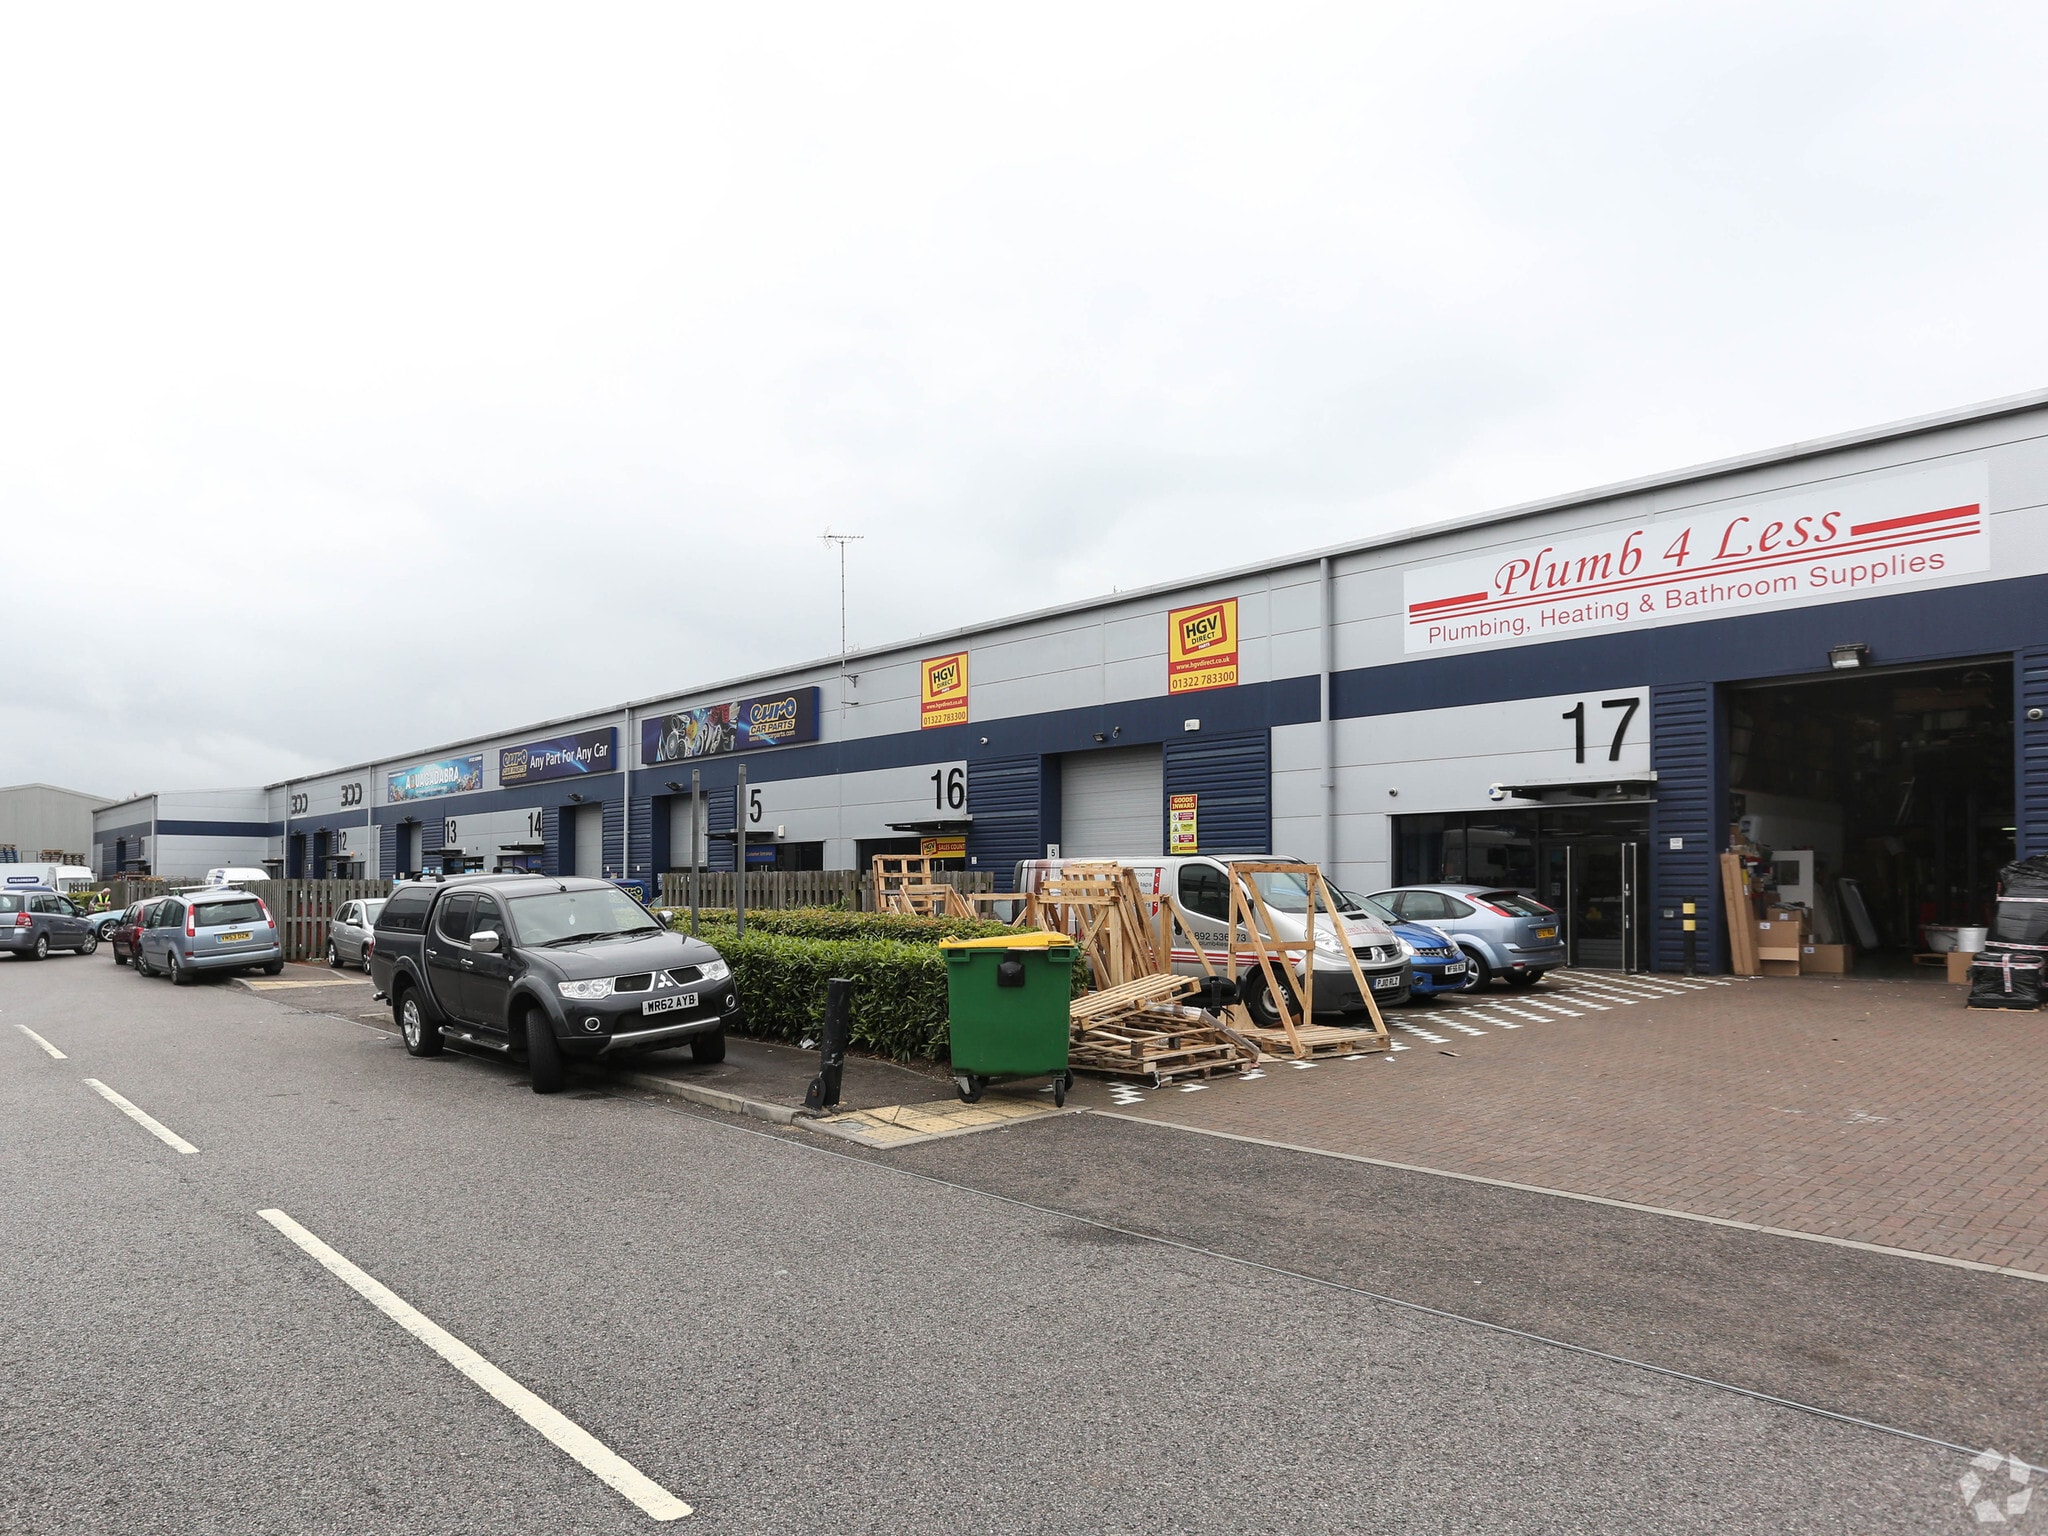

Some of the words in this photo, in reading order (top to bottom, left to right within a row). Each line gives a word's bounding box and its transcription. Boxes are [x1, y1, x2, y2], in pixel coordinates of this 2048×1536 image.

[1495, 530, 1642, 597] Plumb
[1663, 527, 1691, 567] 4
[1711, 511, 1841, 560] Less
[1429, 617, 1531, 644] Plumbing,
[1541, 601, 1629, 627] Heating
[1639, 593, 1656, 613] &
[1666, 575, 1797, 609] Bathroom
[1809, 552, 1945, 587] Supplies
[1185, 614, 1218, 639] HGV
[1191, 631, 1215, 645] DIRECT
[1176, 656, 1230, 670] www.hgvdirect.co.uk
[933, 665, 955, 684] HGV
[937, 678, 953, 689] DIRECT
[1172, 676, 1199, 689] 01322
[1201, 671, 1234, 685] 783300
[750, 697, 797, 724] euro
[924, 714, 941, 725] 01322
[943, 711, 966, 722] 783300
[751, 725, 767, 734] CAR
[768, 720, 793, 731] PARTS
[1562, 697, 1640, 765] 17
[530, 755, 545, 770] Any
[545, 752, 560, 766] Part
[562, 749, 575, 763] For
[576, 746, 592, 763] Any
[594, 743, 608, 758] Car
[931, 768, 965, 810] 16
[445, 820, 457, 843] 13
[527, 811, 542, 838] 14
[339, 831, 347, 851] 12
[1051, 849, 1056, 857] 5
[648, 998, 674, 1013] WR62
[676, 994, 696, 1008] AYB
